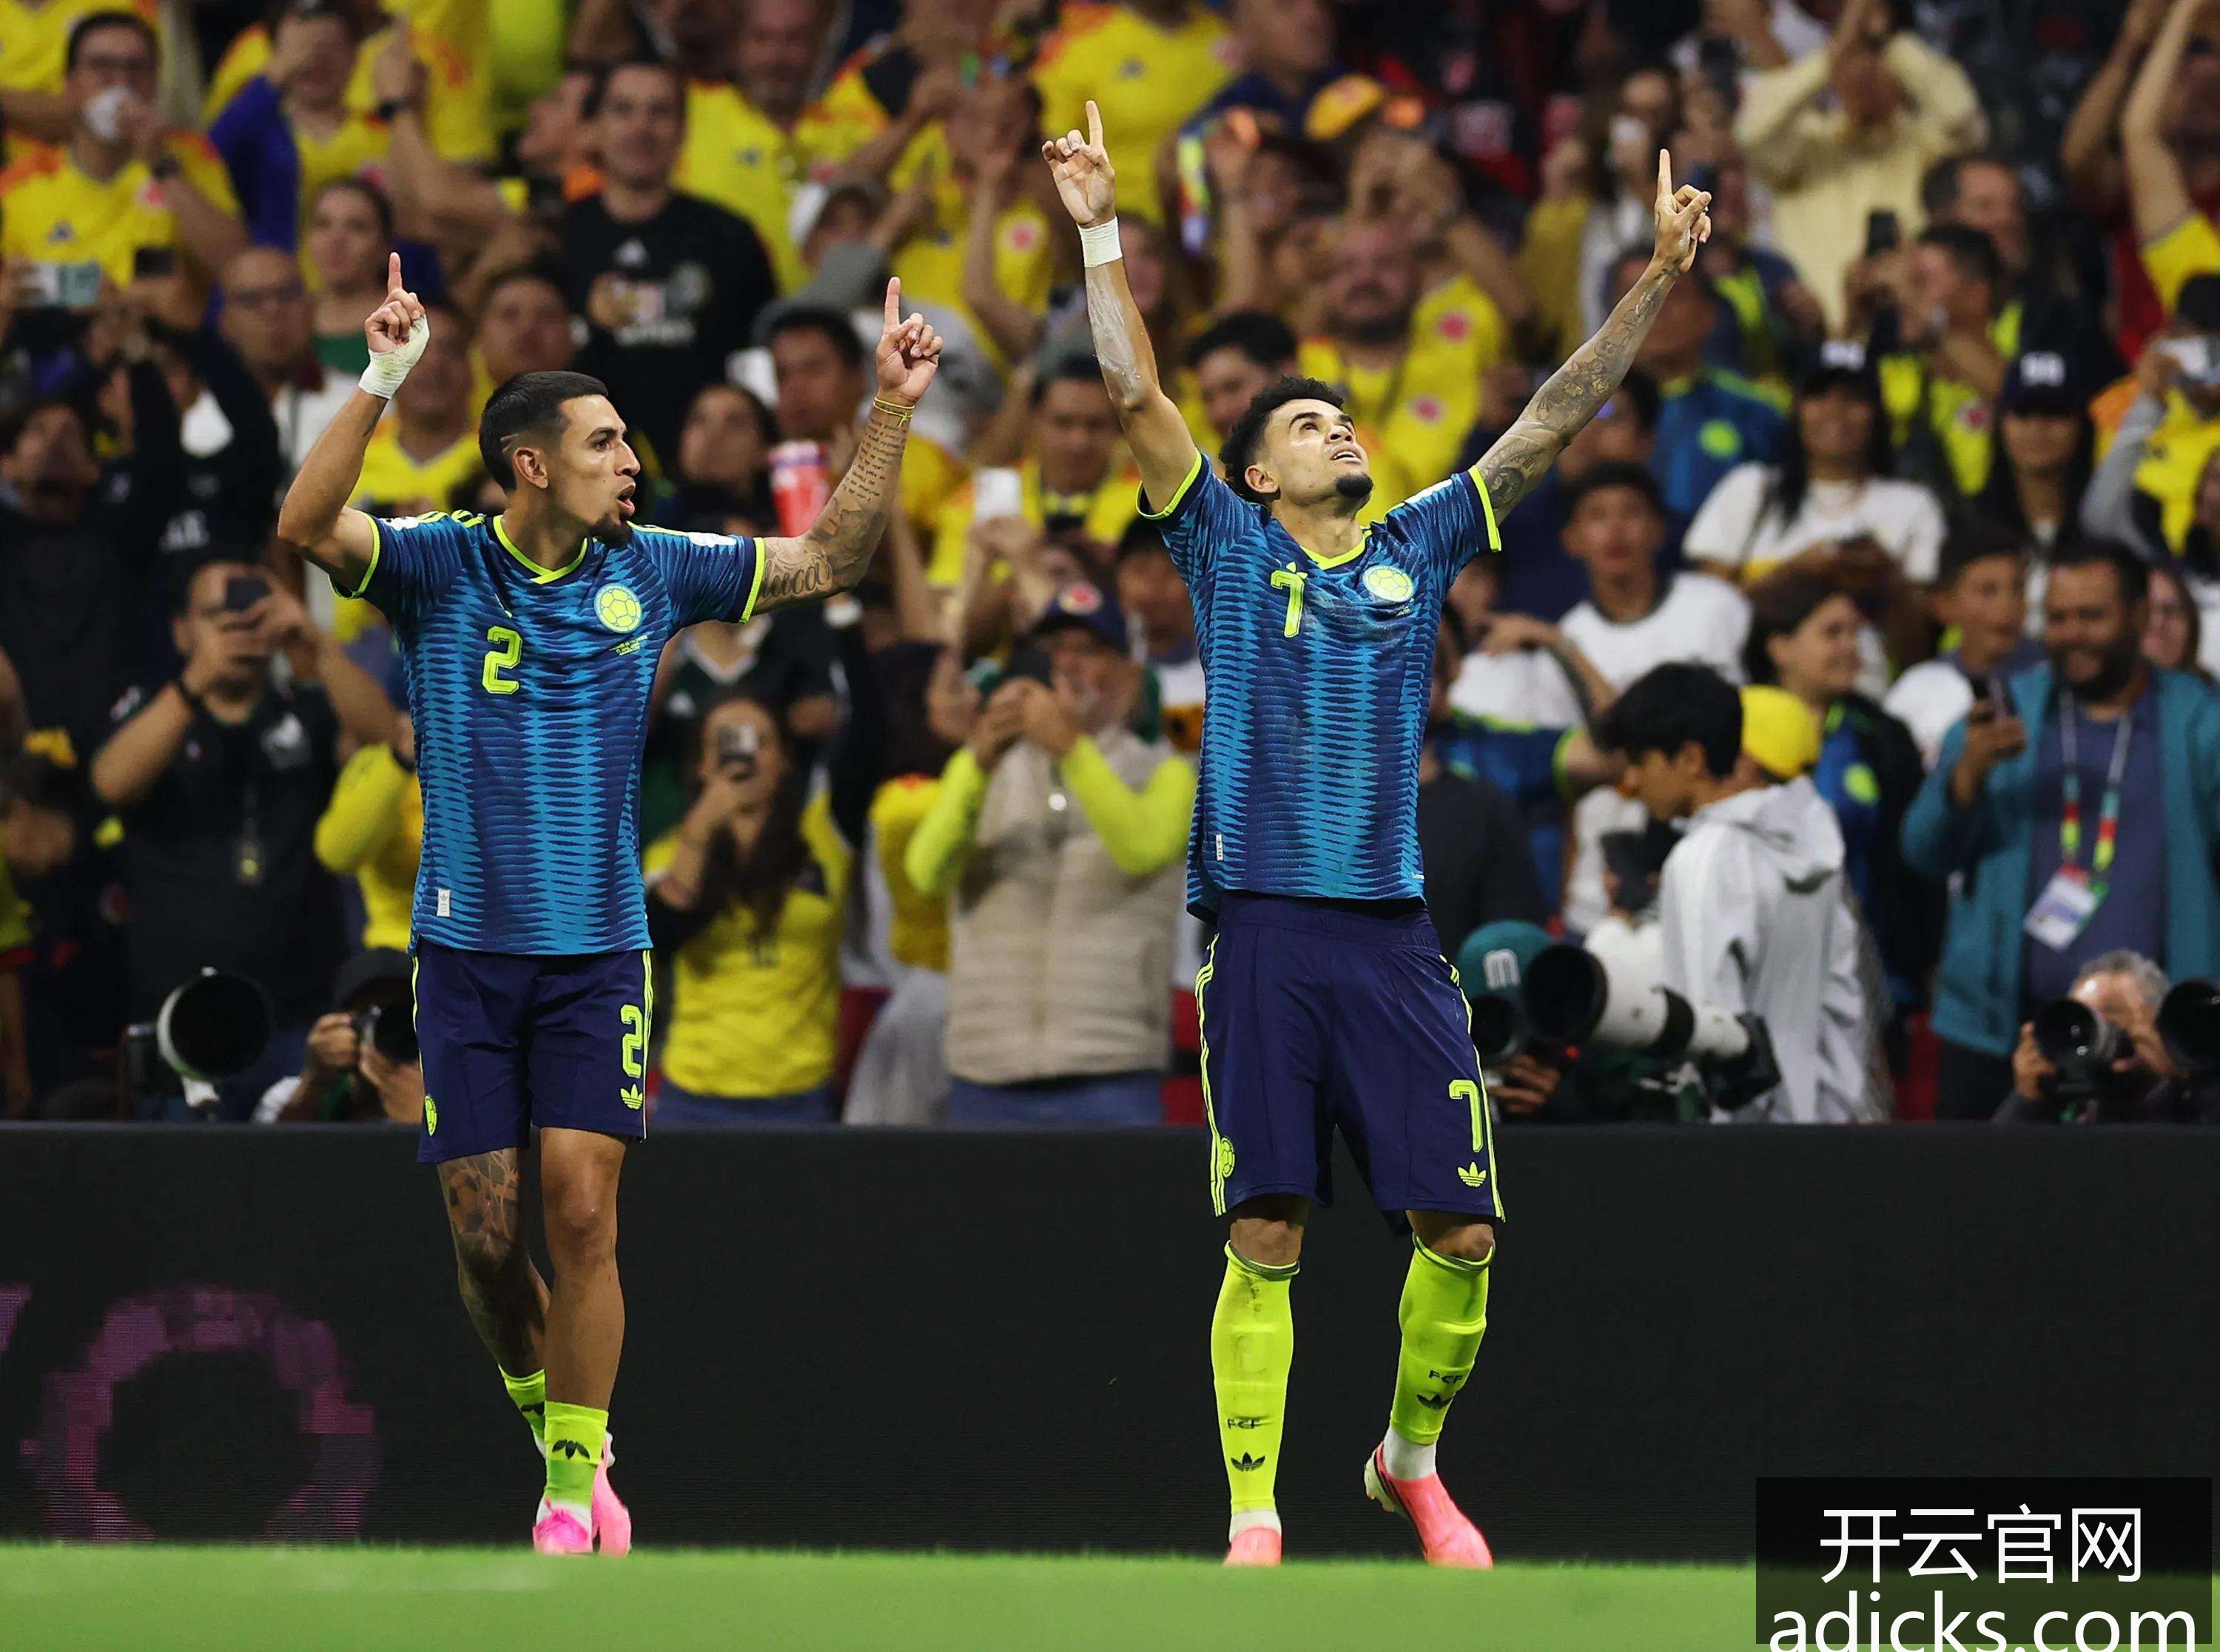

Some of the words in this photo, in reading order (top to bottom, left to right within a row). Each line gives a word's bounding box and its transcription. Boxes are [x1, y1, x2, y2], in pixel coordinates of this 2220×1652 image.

[1271, 570, 1305, 638] 7
[482, 625, 523, 695] 2
[620, 1004, 643, 1079] 2
[1448, 1079, 1484, 1153] 7
[1428, 1369, 1464, 1384] FCF
[1228, 1416, 1261, 1429] FCF
